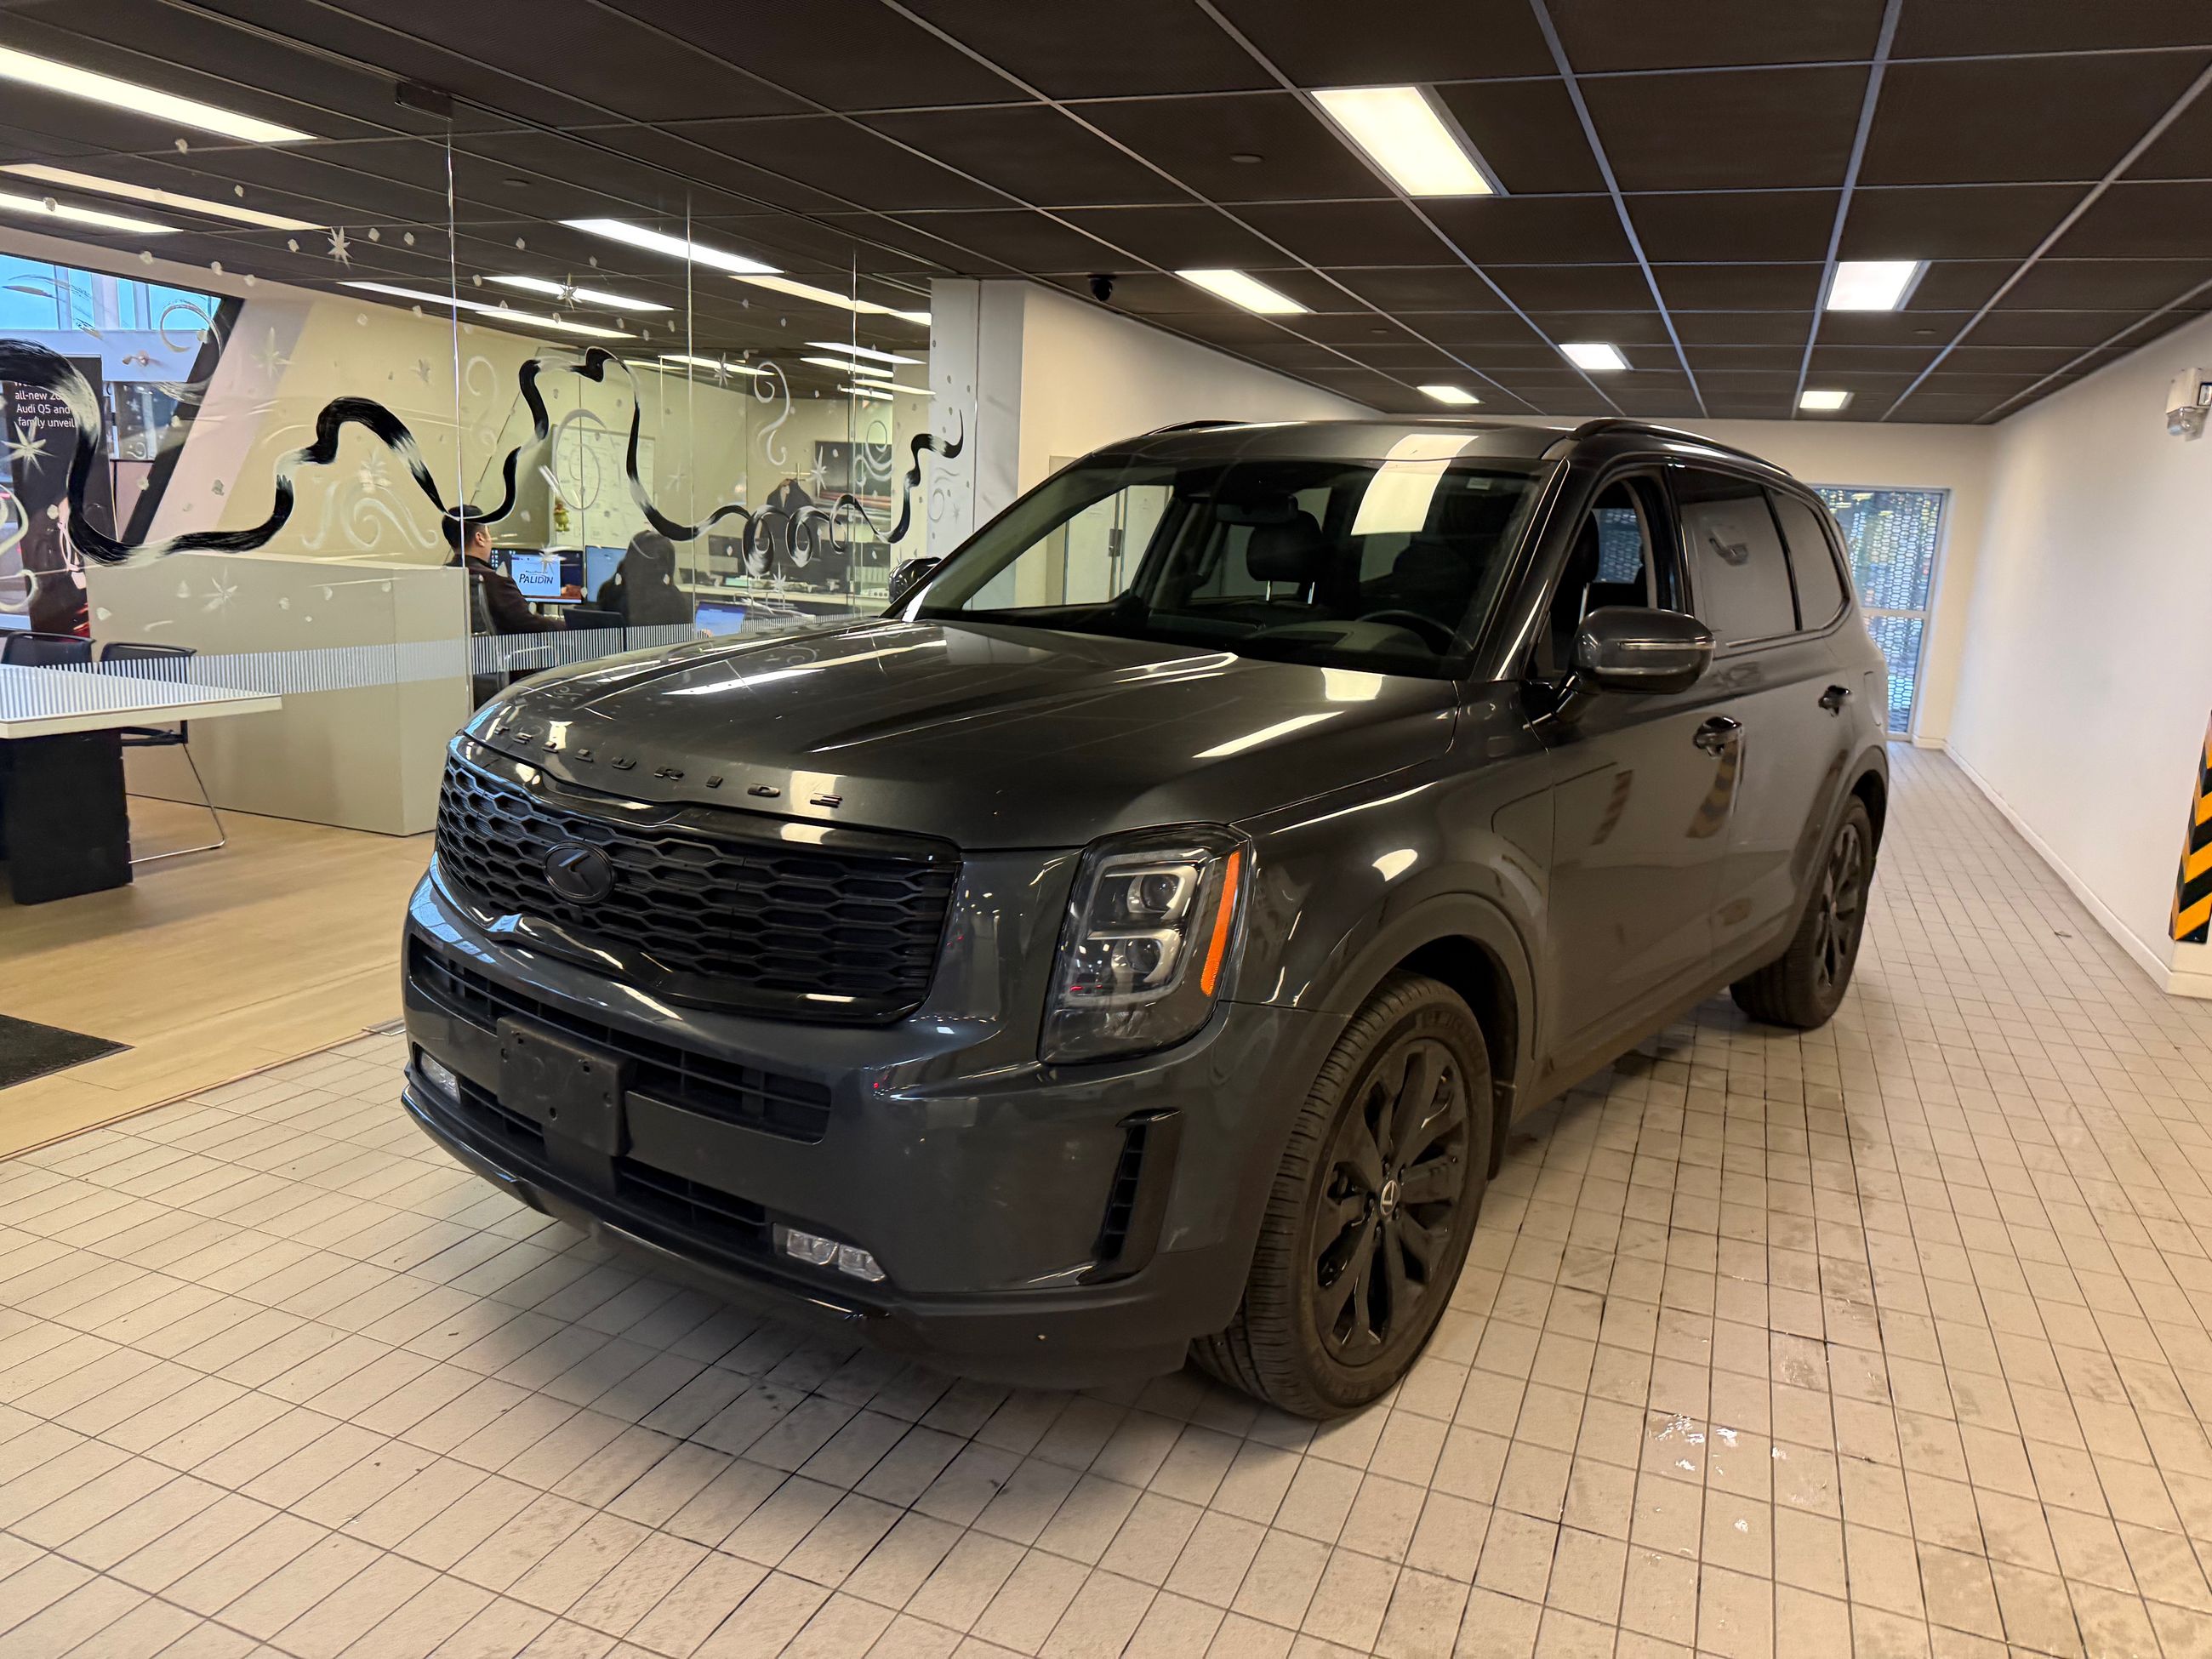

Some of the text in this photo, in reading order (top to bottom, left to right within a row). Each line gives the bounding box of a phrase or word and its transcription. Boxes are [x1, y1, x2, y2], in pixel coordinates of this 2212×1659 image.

[14, 391, 48, 400] all-new
[16, 403, 36, 413] Audi
[37, 404, 51, 415] Q5
[18, 416, 46, 430] famly
